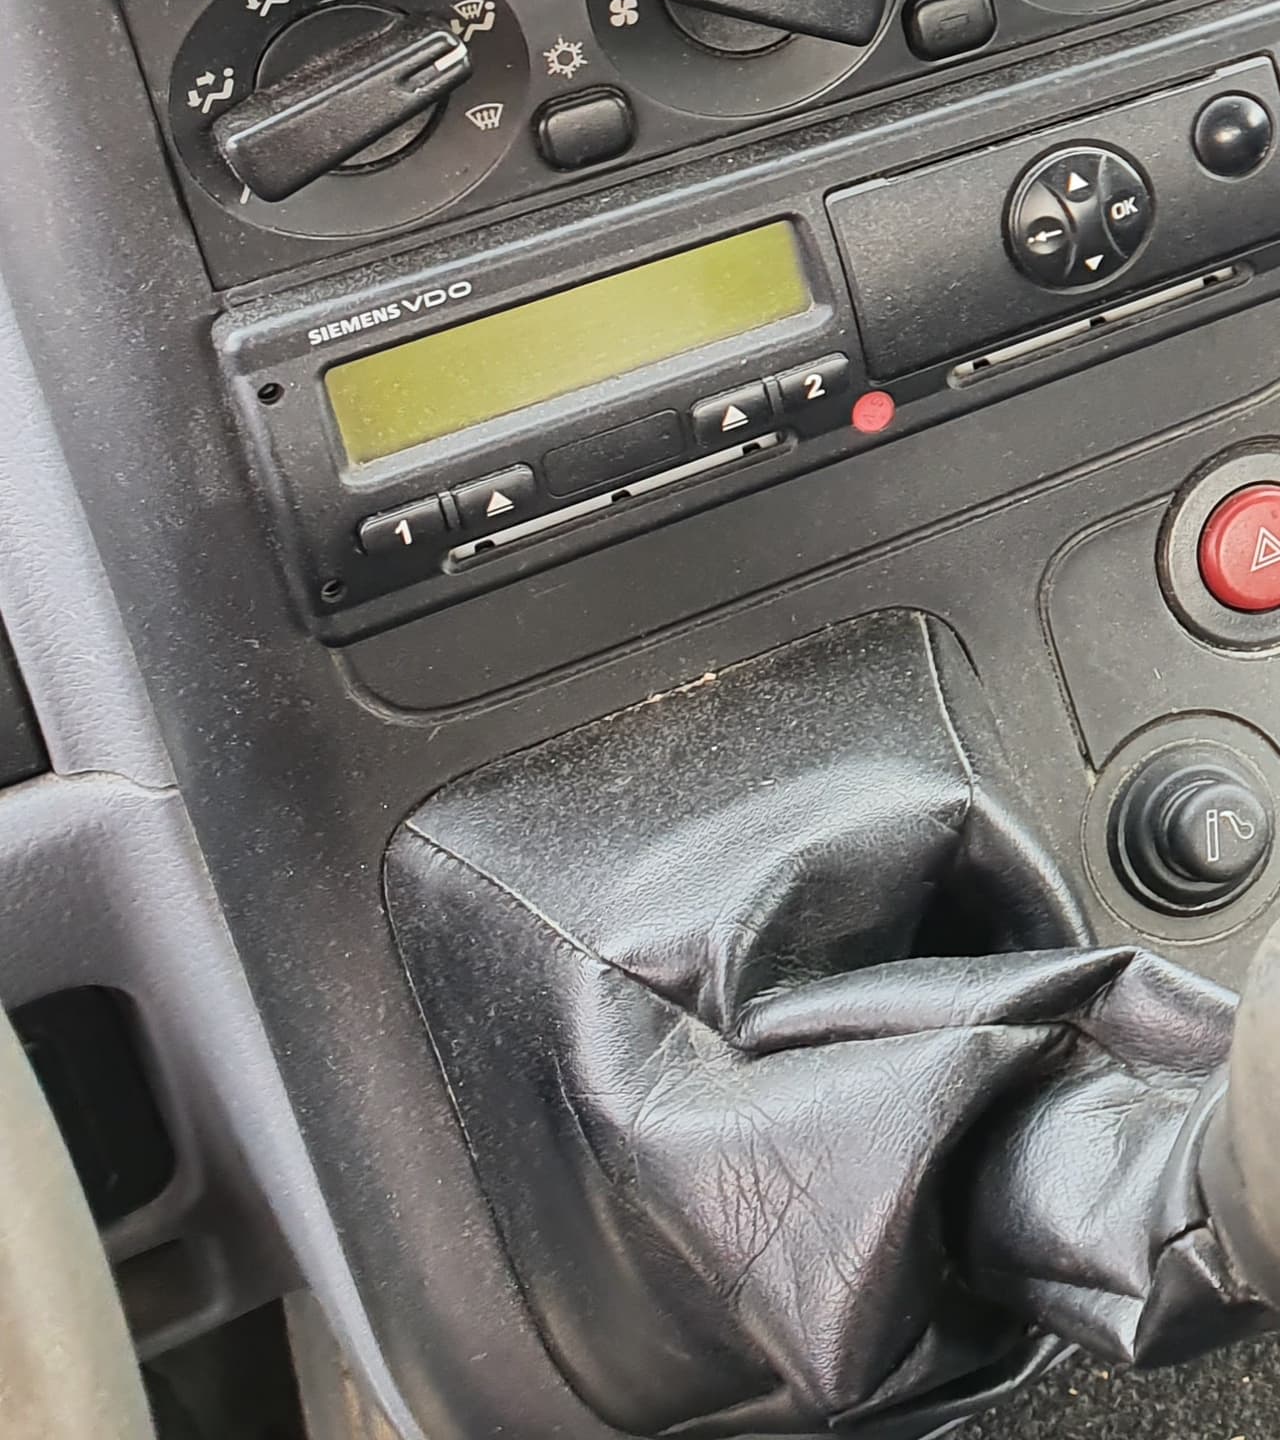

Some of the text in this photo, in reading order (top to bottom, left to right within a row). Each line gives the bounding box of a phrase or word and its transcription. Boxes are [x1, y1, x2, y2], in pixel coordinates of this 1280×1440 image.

[1111, 196, 1139, 220] OK
[308, 281, 472, 345] SIEMENS VDO
[804, 373, 826, 400] 2
[395, 519, 412, 545] 1
